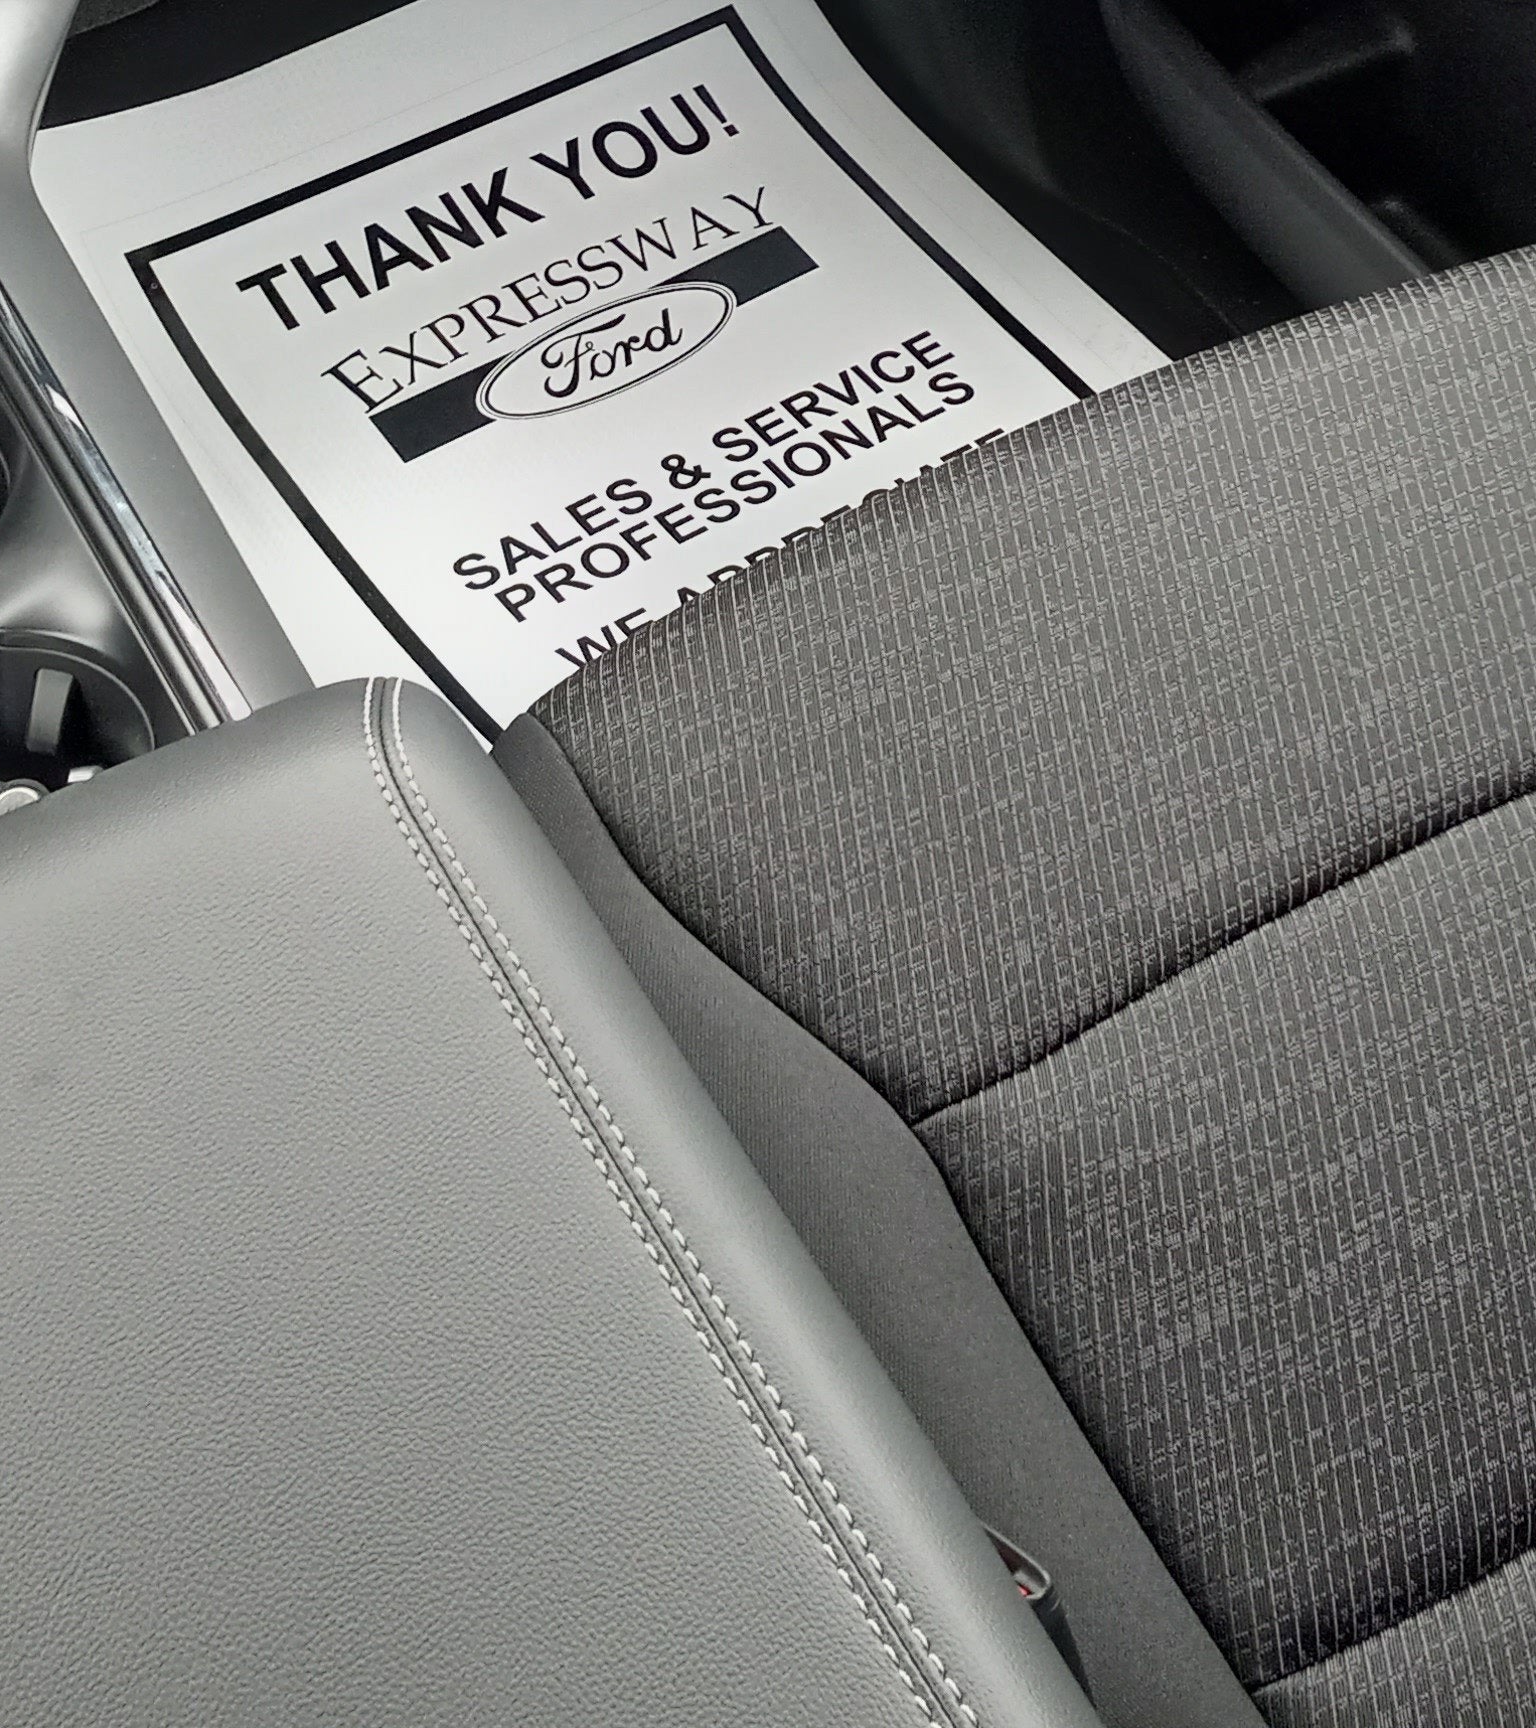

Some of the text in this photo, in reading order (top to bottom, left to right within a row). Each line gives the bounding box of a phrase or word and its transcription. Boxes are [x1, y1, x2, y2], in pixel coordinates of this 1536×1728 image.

[235, 83, 741, 332] THANK YOU!
[321, 186, 775, 415] EXPRESSWAY
[452, 476, 654, 592] SALES
[659, 452, 712, 491] &
[710, 330, 957, 465] SERVICE
[539, 306, 685, 400] Ford
[493, 371, 977, 625] PROFESSIONALS
